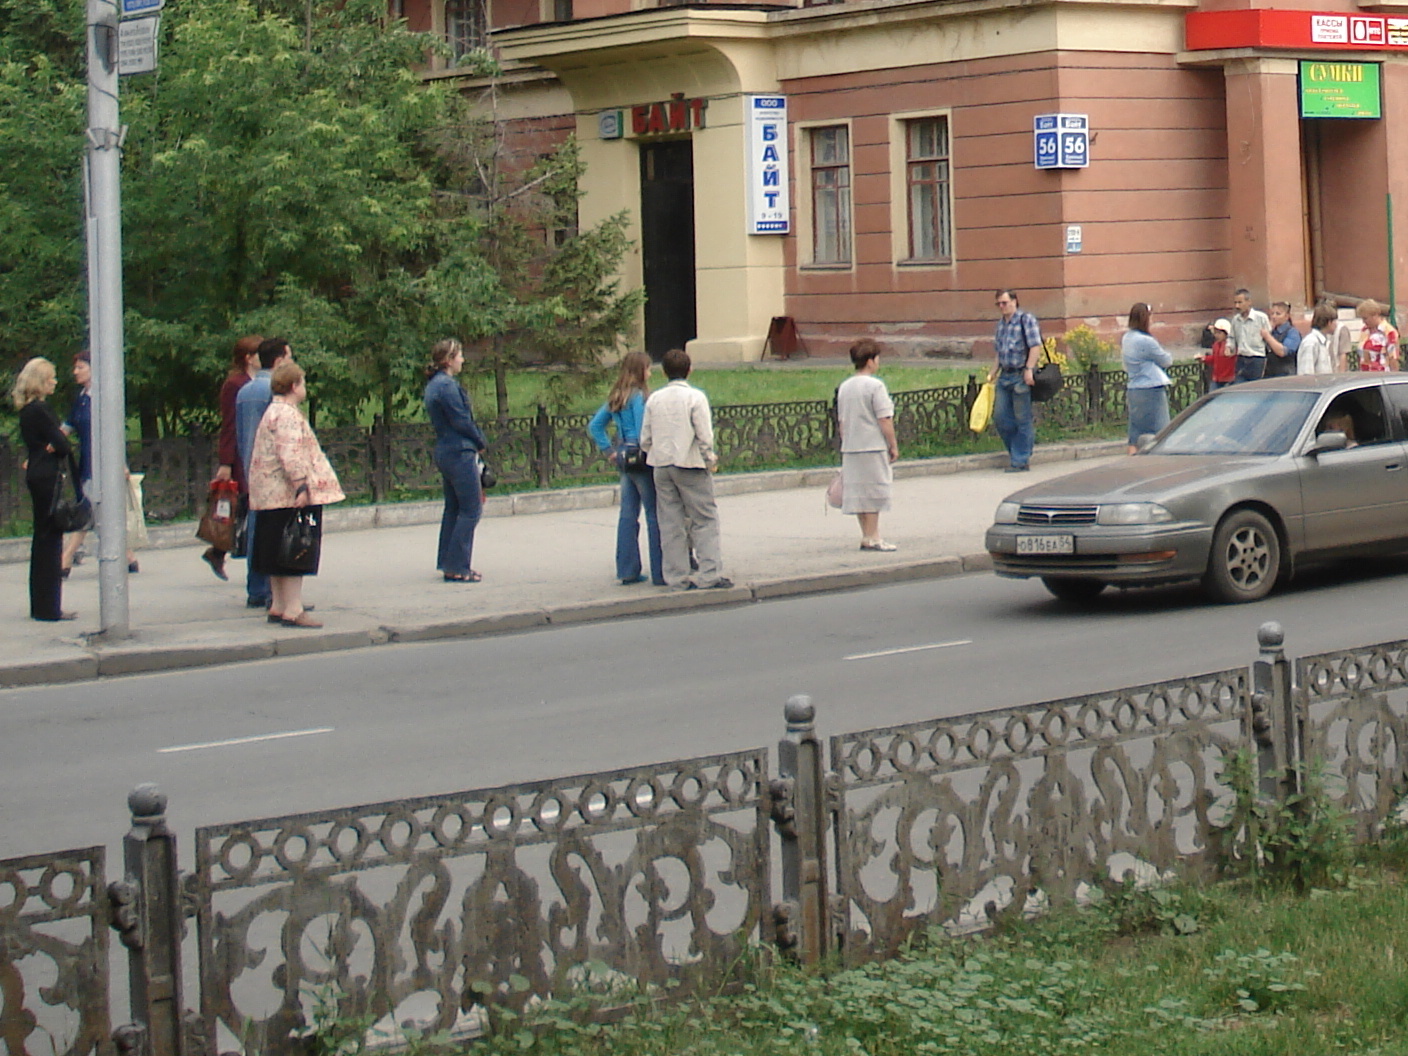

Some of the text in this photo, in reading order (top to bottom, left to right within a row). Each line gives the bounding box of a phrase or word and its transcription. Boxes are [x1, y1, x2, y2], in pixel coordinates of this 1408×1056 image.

[1309, 63, 1363, 82] СУМКИ
[631, 92, 708, 135] БАЙТ
[1039, 137, 1056, 155] 56
[1064, 137, 1085, 154] 56
[762, 123, 779, 209] БАЙТ
